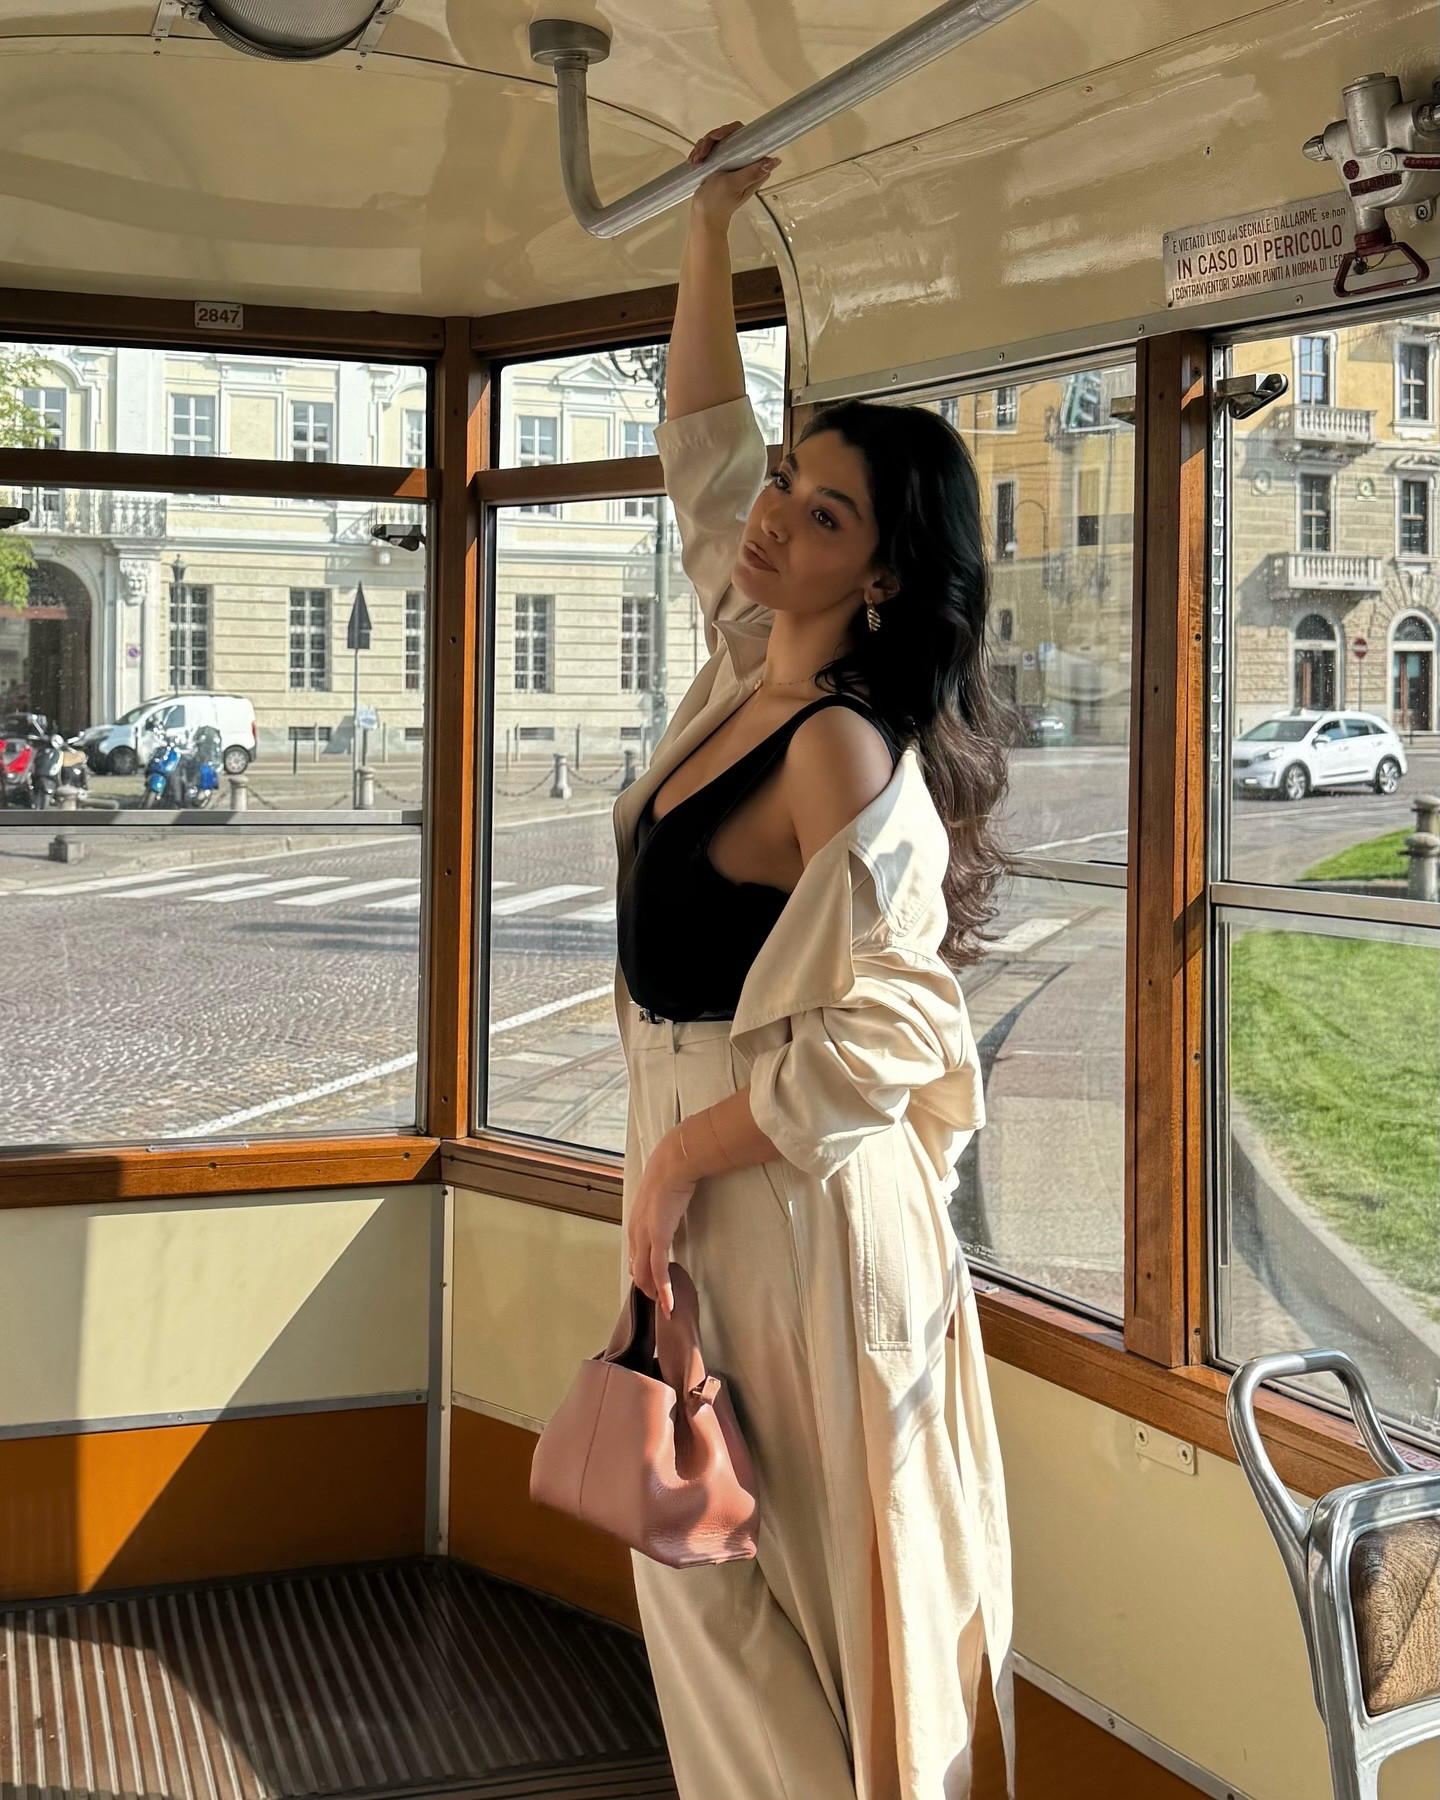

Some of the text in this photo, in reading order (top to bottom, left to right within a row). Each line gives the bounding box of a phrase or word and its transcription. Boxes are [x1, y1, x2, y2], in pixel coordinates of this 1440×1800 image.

[1179, 234, 1205, 252] VIETATO
[1228, 227, 1238, 242] del
[1238, 218, 1271, 239] SEGNALE
[1321, 211, 1329, 220] se
[1332, 207, 1345, 218] non
[1177, 224, 1343, 281] IN CASO DI PERICOLO
[1175, 277, 1230, 300] CONTRAVVENTORI
[1231, 271, 1262, 289] SARANNO
[1262, 264, 1284, 283] PUNITI
[1285, 264, 1291, 279] A
[1292, 259, 1318, 278] NORMA
[1320, 257, 1327, 272] DI
[198, 307, 239, 324] 2847
